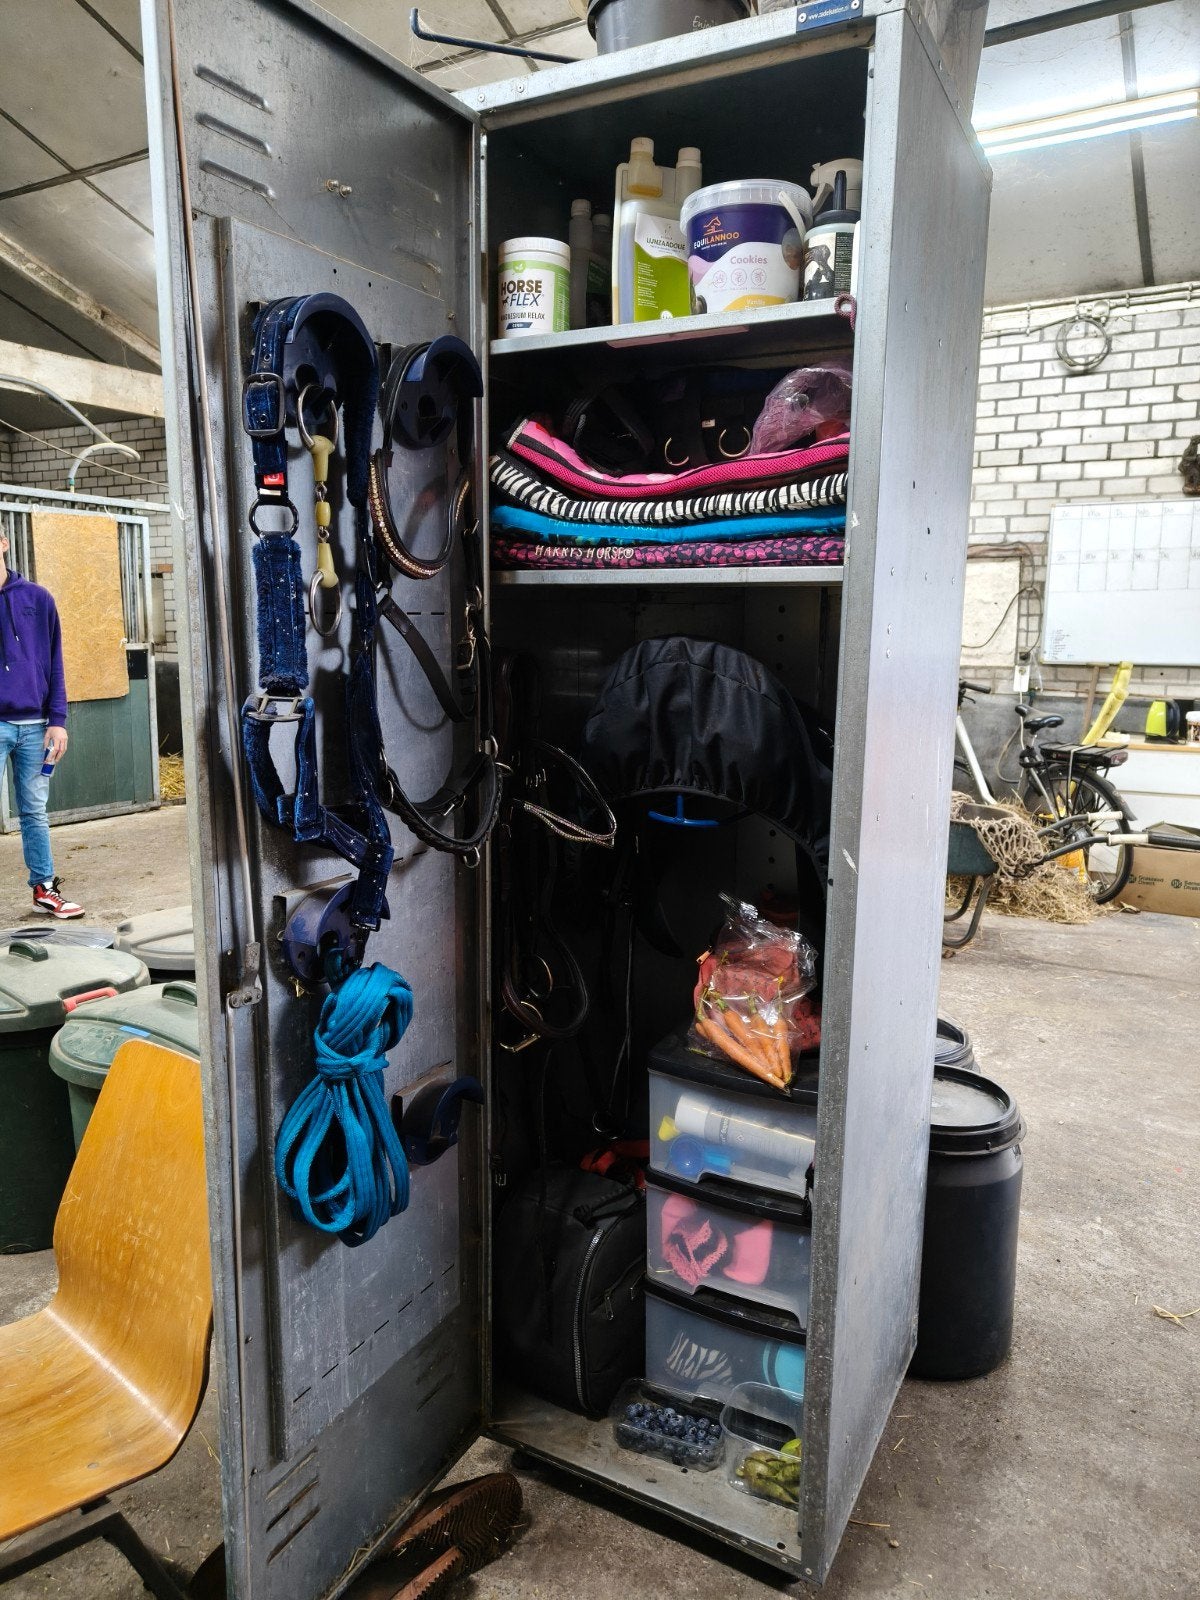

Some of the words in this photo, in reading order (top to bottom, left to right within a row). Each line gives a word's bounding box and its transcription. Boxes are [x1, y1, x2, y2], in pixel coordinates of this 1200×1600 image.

[694, 231, 740, 249] EQUILANNOO
[730, 254, 768, 265] Cookies
[501, 280, 542, 296] HORSE
[510, 293, 542, 306] FLEX
[535, 544, 583, 558] HARRYS
